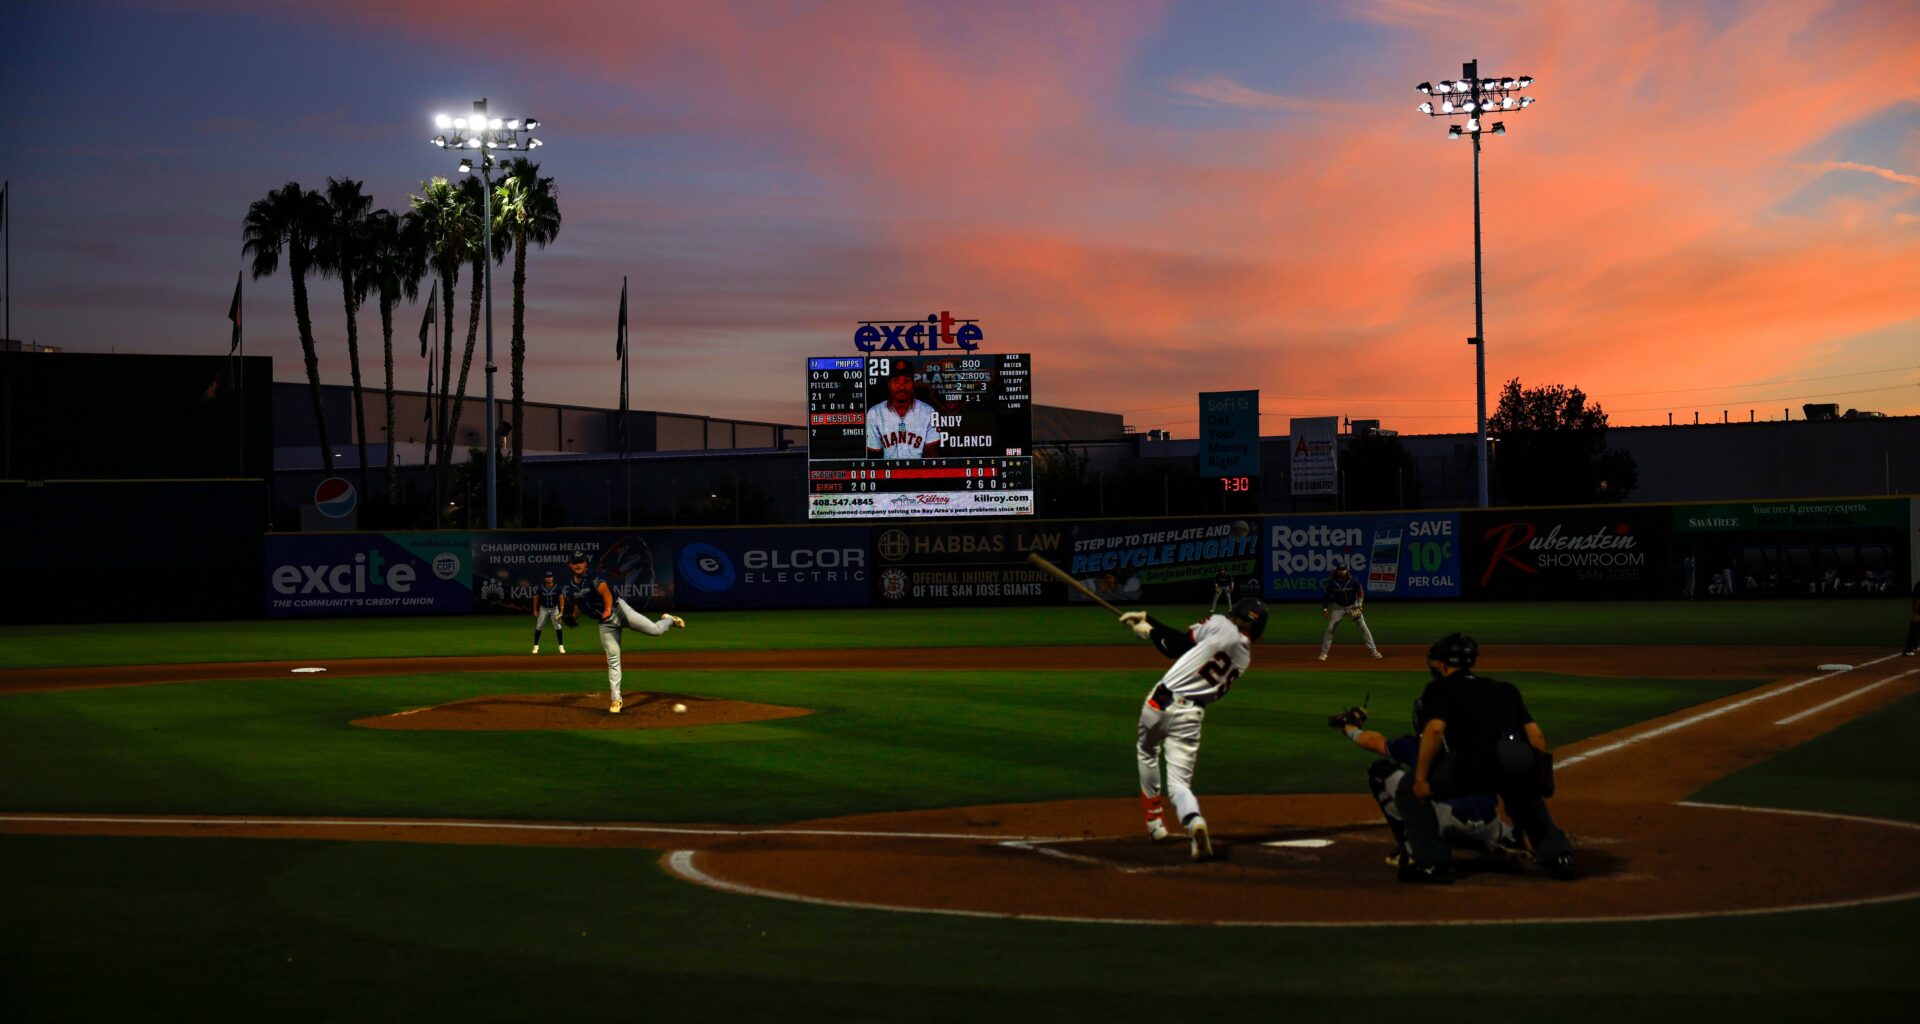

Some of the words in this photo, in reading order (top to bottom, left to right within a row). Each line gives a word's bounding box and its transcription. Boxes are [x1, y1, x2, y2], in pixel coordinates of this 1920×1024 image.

[854, 311, 983, 352] excite
[835, 360, 860, 369] PHIPPS
[869, 358, 890, 376] 29
[959, 359, 981, 368] .800
[843, 371, 863, 380] 0.00
[854, 381, 863, 389] 44
[956, 382, 963, 391] 2
[980, 382, 988, 391] 3
[812, 392, 822, 401] 2.1
[811, 403, 817, 411] 3
[830, 402, 836, 411] 0
[849, 402, 855, 410] 4
[1208, 398, 1234, 411] SoFi
[826, 414, 863, 423] RESULTS
[1208, 429, 1237, 440] Your
[1006, 447, 1022, 456] MPH
[1208, 443, 1249, 455] Money
[1208, 456, 1240, 469] Right
[990, 468, 997, 477] 1
[815, 483, 844, 491] GIANTS
[851, 482, 857, 491] 2
[860, 482, 867, 491] 0
[870, 482, 877, 491] 0
[965, 480, 972, 489] 2
[978, 480, 984, 489] 6
[990, 480, 997, 489] 0
[1220, 477, 1249, 491] 7:30
[812, 498, 874, 506] 408.547.4845
[915, 494, 951, 505] Killroy
[974, 494, 1029, 504] killroy.com
[888, 508, 910, 516] solving
[1752, 504, 1771, 515] Your
[1772, 504, 1788, 513] tree
[1789, 503, 1796, 513] &
[1797, 503, 1834, 515] greenery
[1408, 520, 1453, 536] SAVE
[914, 534, 1005, 554] HABBAS
[1017, 532, 1062, 551] LAW
[1074, 538, 1105, 552] STEP
[1106, 535, 1123, 549] UP
[1124, 534, 1141, 547] TO
[1141, 531, 1166, 545] THE
[1166, 527, 1205, 542] PLATE
[1204, 524, 1232, 538] AND
[1271, 525, 1363, 550] Rotten
[480, 543, 557, 552] CHAMPIONING
[559, 542, 600, 551] HEALTH
[490, 554, 502, 564] IN
[503, 554, 526, 563] OUR
[1071, 544, 1178, 574] RECYCLE
[1177, 535, 1260, 563] RIGHT!
[1407, 540, 1453, 572] 10¢
[1481, 522, 1637, 588] Rubenstein
[1537, 553, 1645, 567] SHOWROOM
[1272, 547, 1367, 575] Robbie
[272, 549, 416, 595] excite
[744, 571, 866, 583] ELECTRIC
[912, 572, 959, 585] OFFICIAL
[962, 571, 999, 583] INJURY
[1576, 569, 1603, 581] SAN
[1606, 568, 1640, 581] JOSE
[1273, 577, 1317, 590] SAVER
[1408, 576, 1430, 587] PER
[1431, 576, 1455, 586] GAL
[912, 585, 927, 598] OF
[929, 585, 950, 597] THE
[951, 584, 973, 597] SAN
[975, 584, 1001, 596] JOSE
[1003, 583, 1042, 596] GIANTS
[273, 599, 292, 608] THE
[293, 598, 364, 608] COMMUNITY'S
[365, 598, 400, 606] CREDIT
[401, 597, 434, 605] UNION
